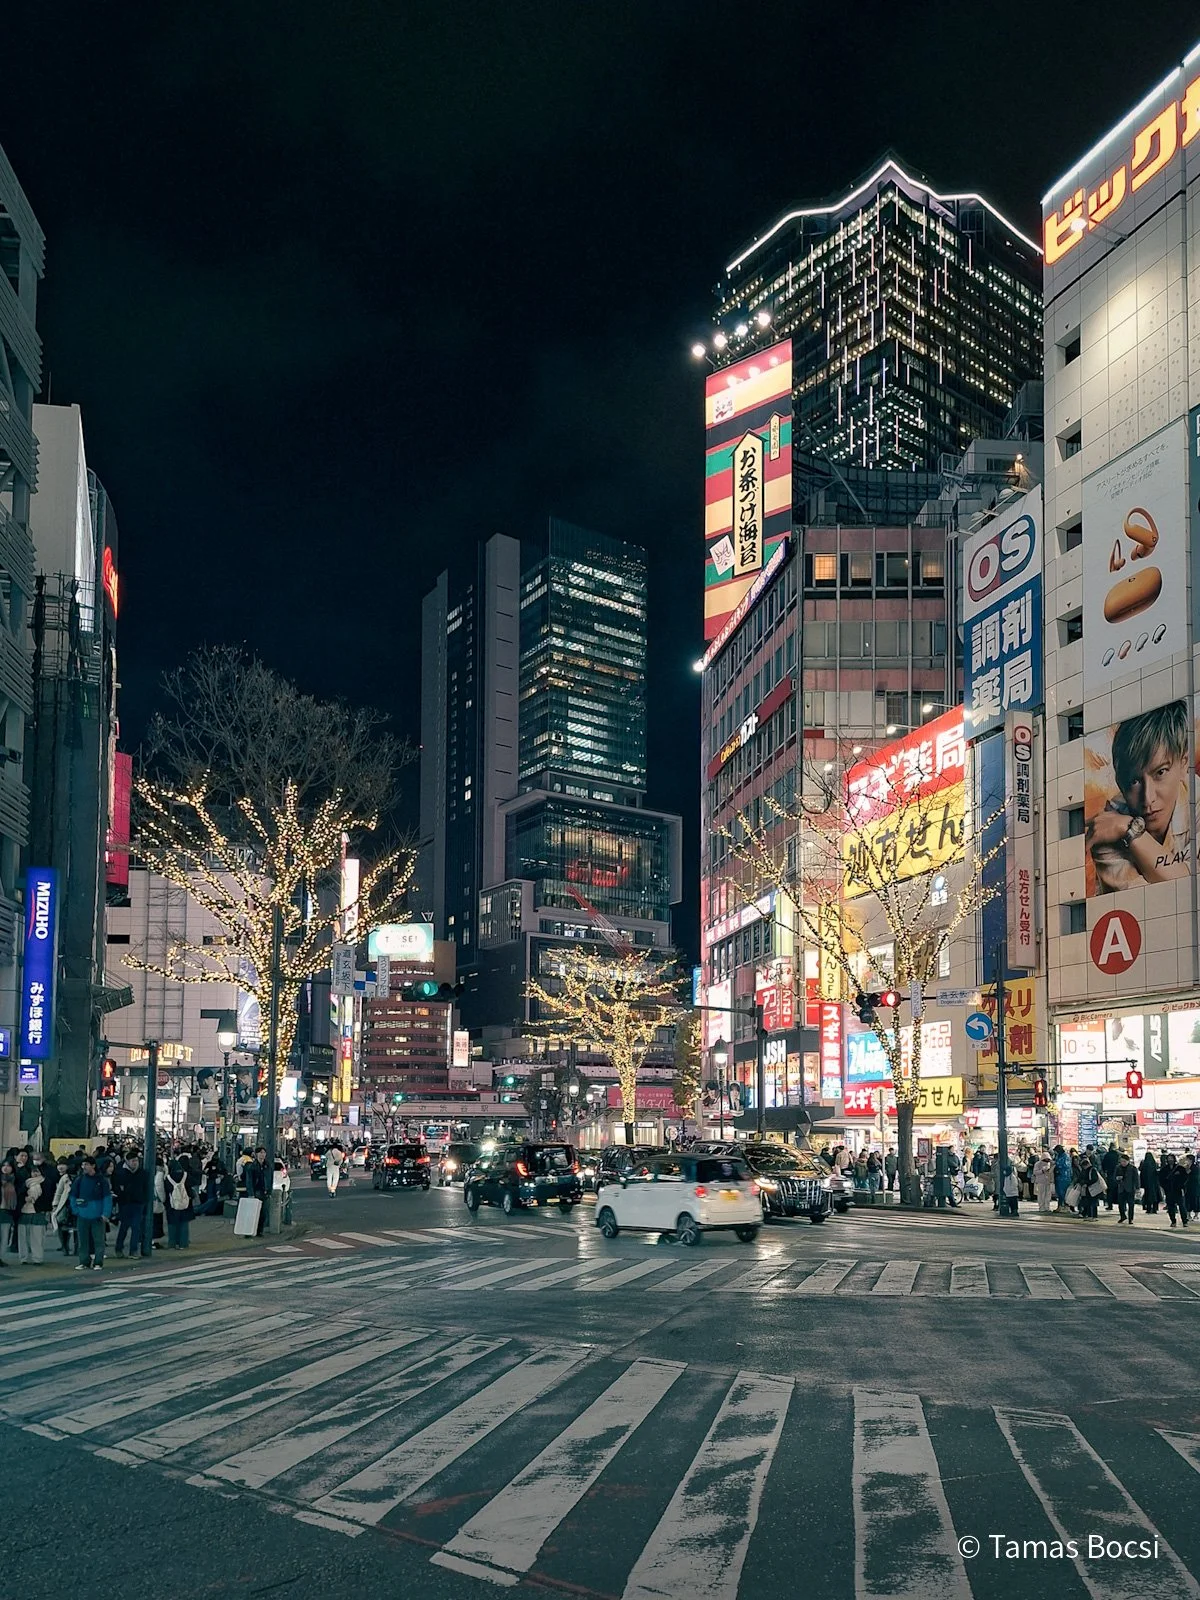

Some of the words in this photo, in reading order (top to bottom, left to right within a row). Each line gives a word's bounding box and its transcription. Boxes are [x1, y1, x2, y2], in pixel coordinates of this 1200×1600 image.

[739, 446, 758, 567] お茶づけ海苔
[970, 518, 1032, 593] OS
[971, 590, 1033, 674] 調剤
[971, 649, 1033, 728] 薬局
[849, 722, 966, 817] スギ薬局
[847, 802, 965, 886] 処方せん
[35, 881, 51, 940] MIZUHO
[1018, 869, 1031, 946] 処方せん受付
[1098, 916, 1134, 965] A
[28, 981, 44, 1045] みずほ銀行
[763, 1039, 787, 1065] USH
[844, 1086, 897, 1110] スギ局
[906, 1085, 962, 1109] 方せん
